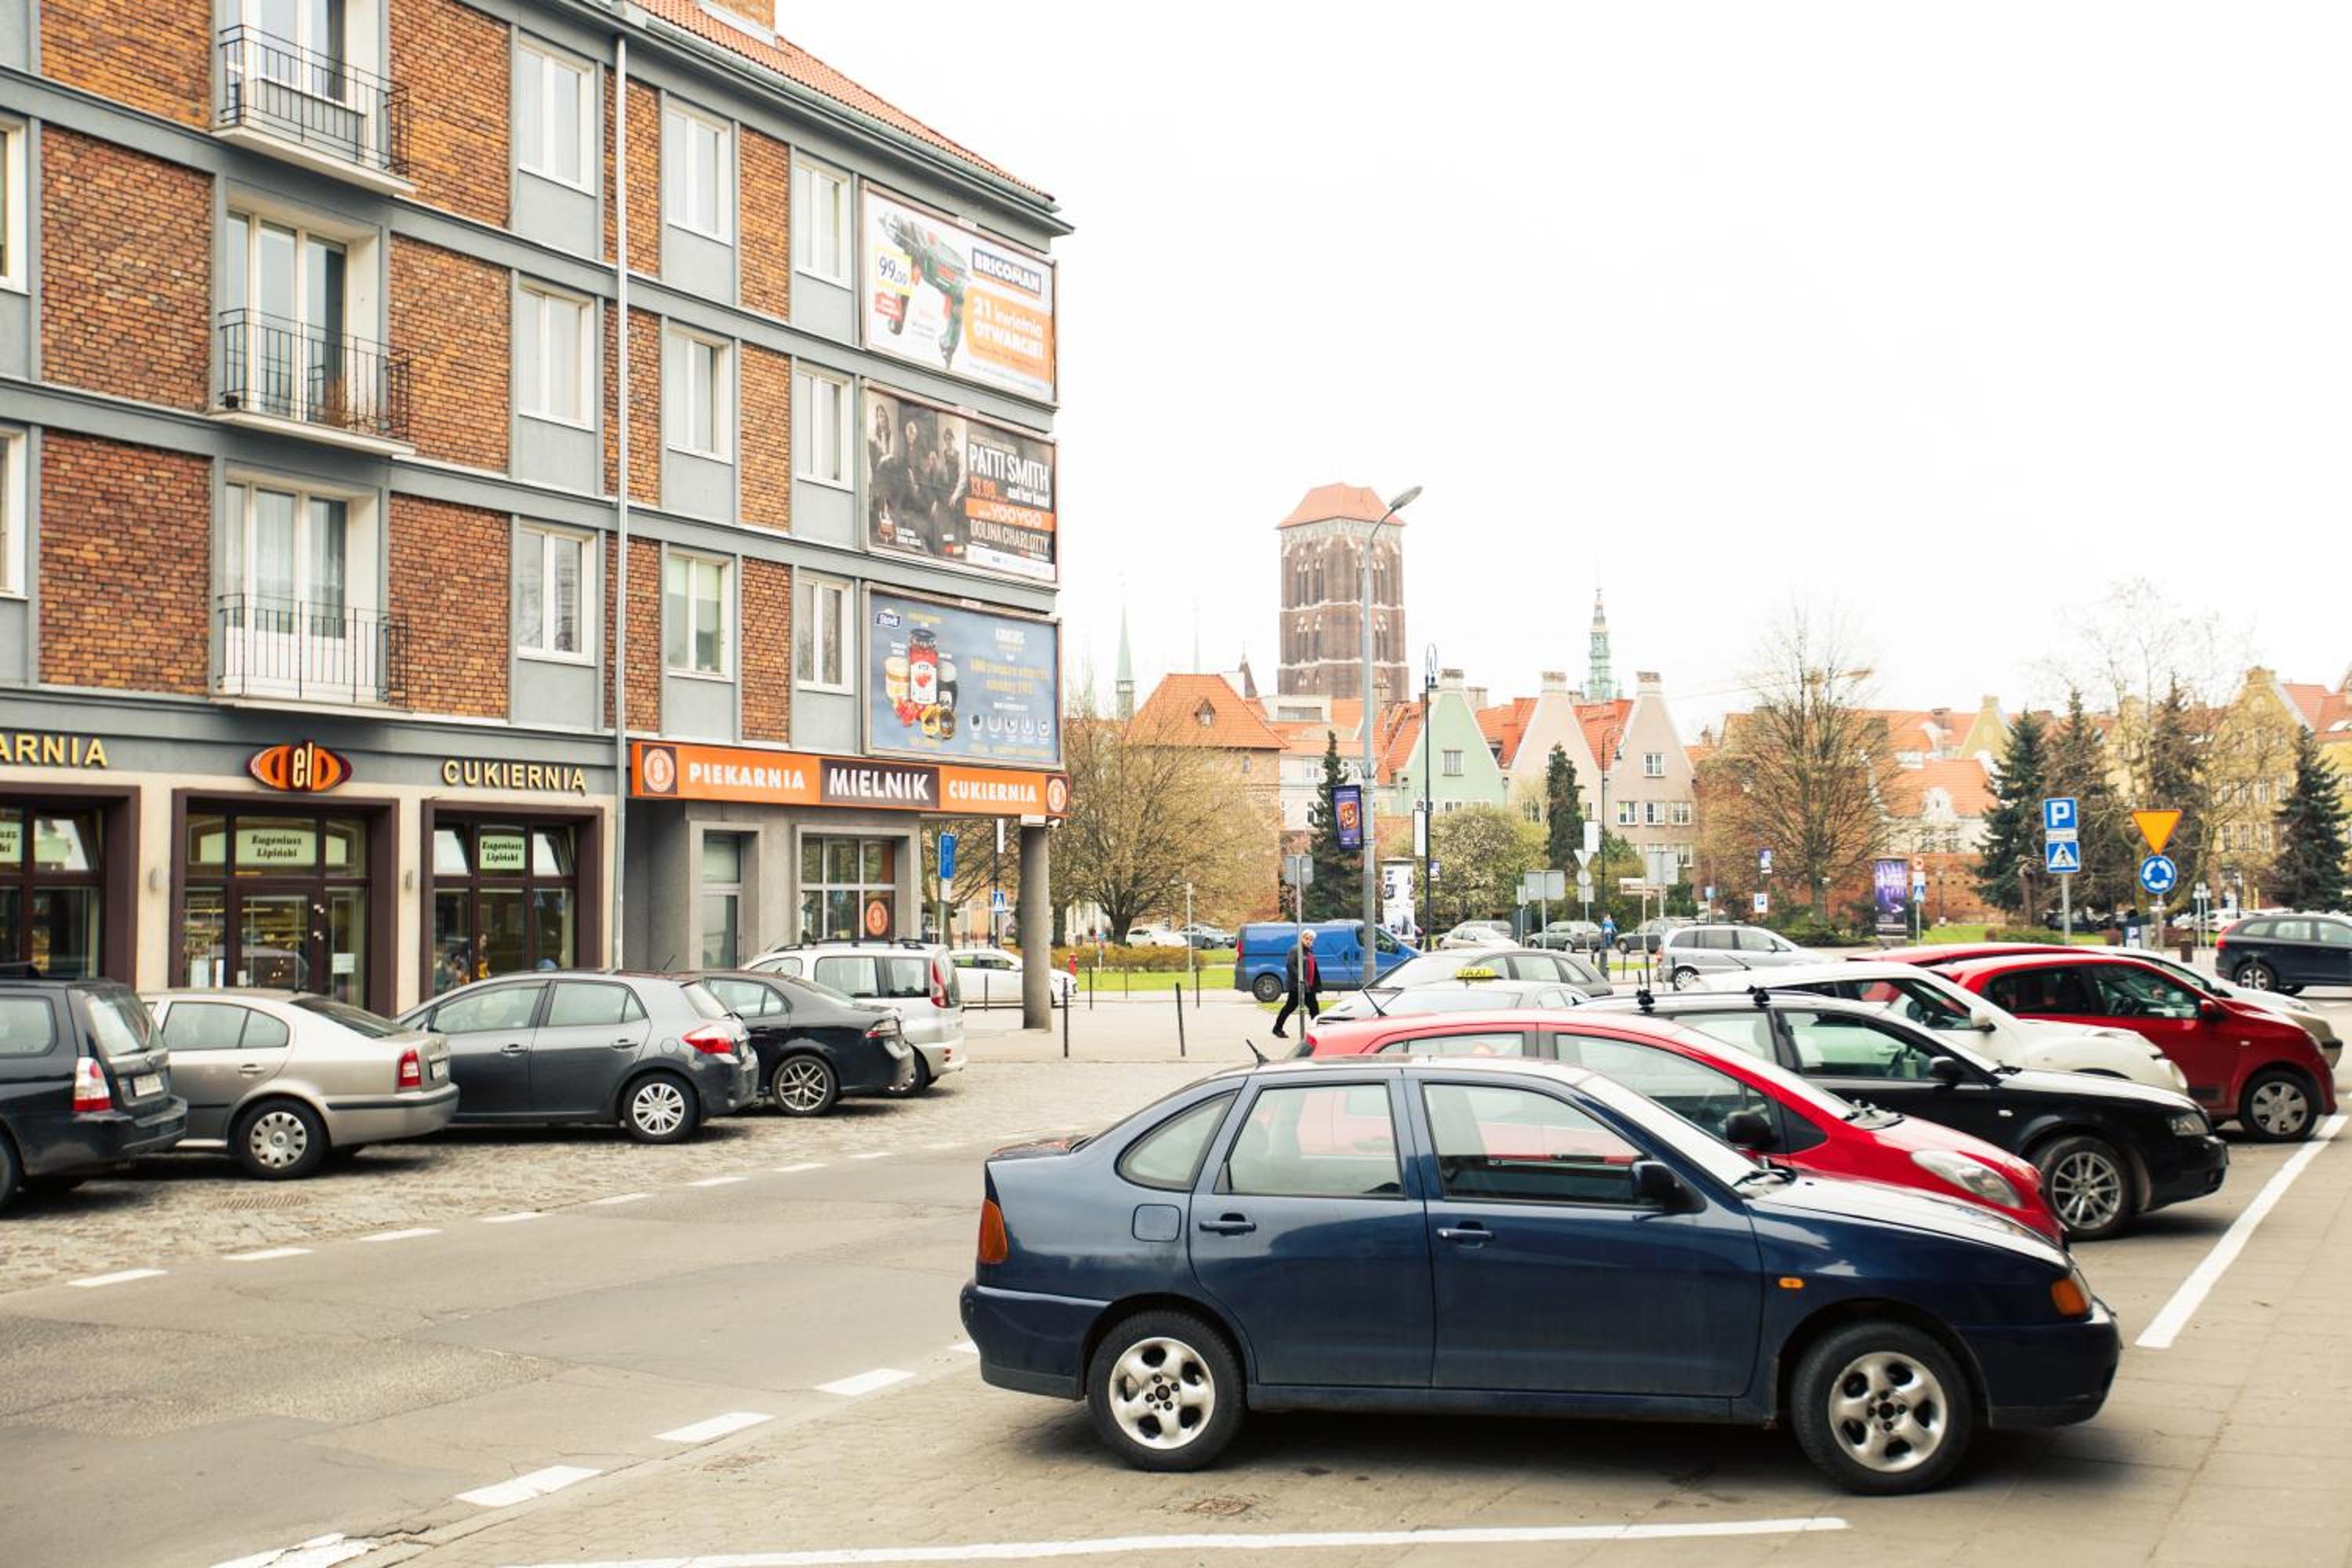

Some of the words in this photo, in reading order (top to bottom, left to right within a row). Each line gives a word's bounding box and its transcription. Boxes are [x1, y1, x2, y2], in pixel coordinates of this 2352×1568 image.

[974, 252, 1040, 292] BRICOMAN
[973, 296, 992, 321] 21
[969, 443, 1005, 481] PATTI
[1007, 454, 1050, 493] SMITH
[970, 518, 1003, 544] DOLINA
[688, 762, 806, 791] PIEKARNIA
[829, 767, 929, 801] MIELNIK
[948, 779, 1036, 804] CUKIERNIA
[2050, 801, 2071, 826] P
[1459, 967, 1486, 977] TAXI
